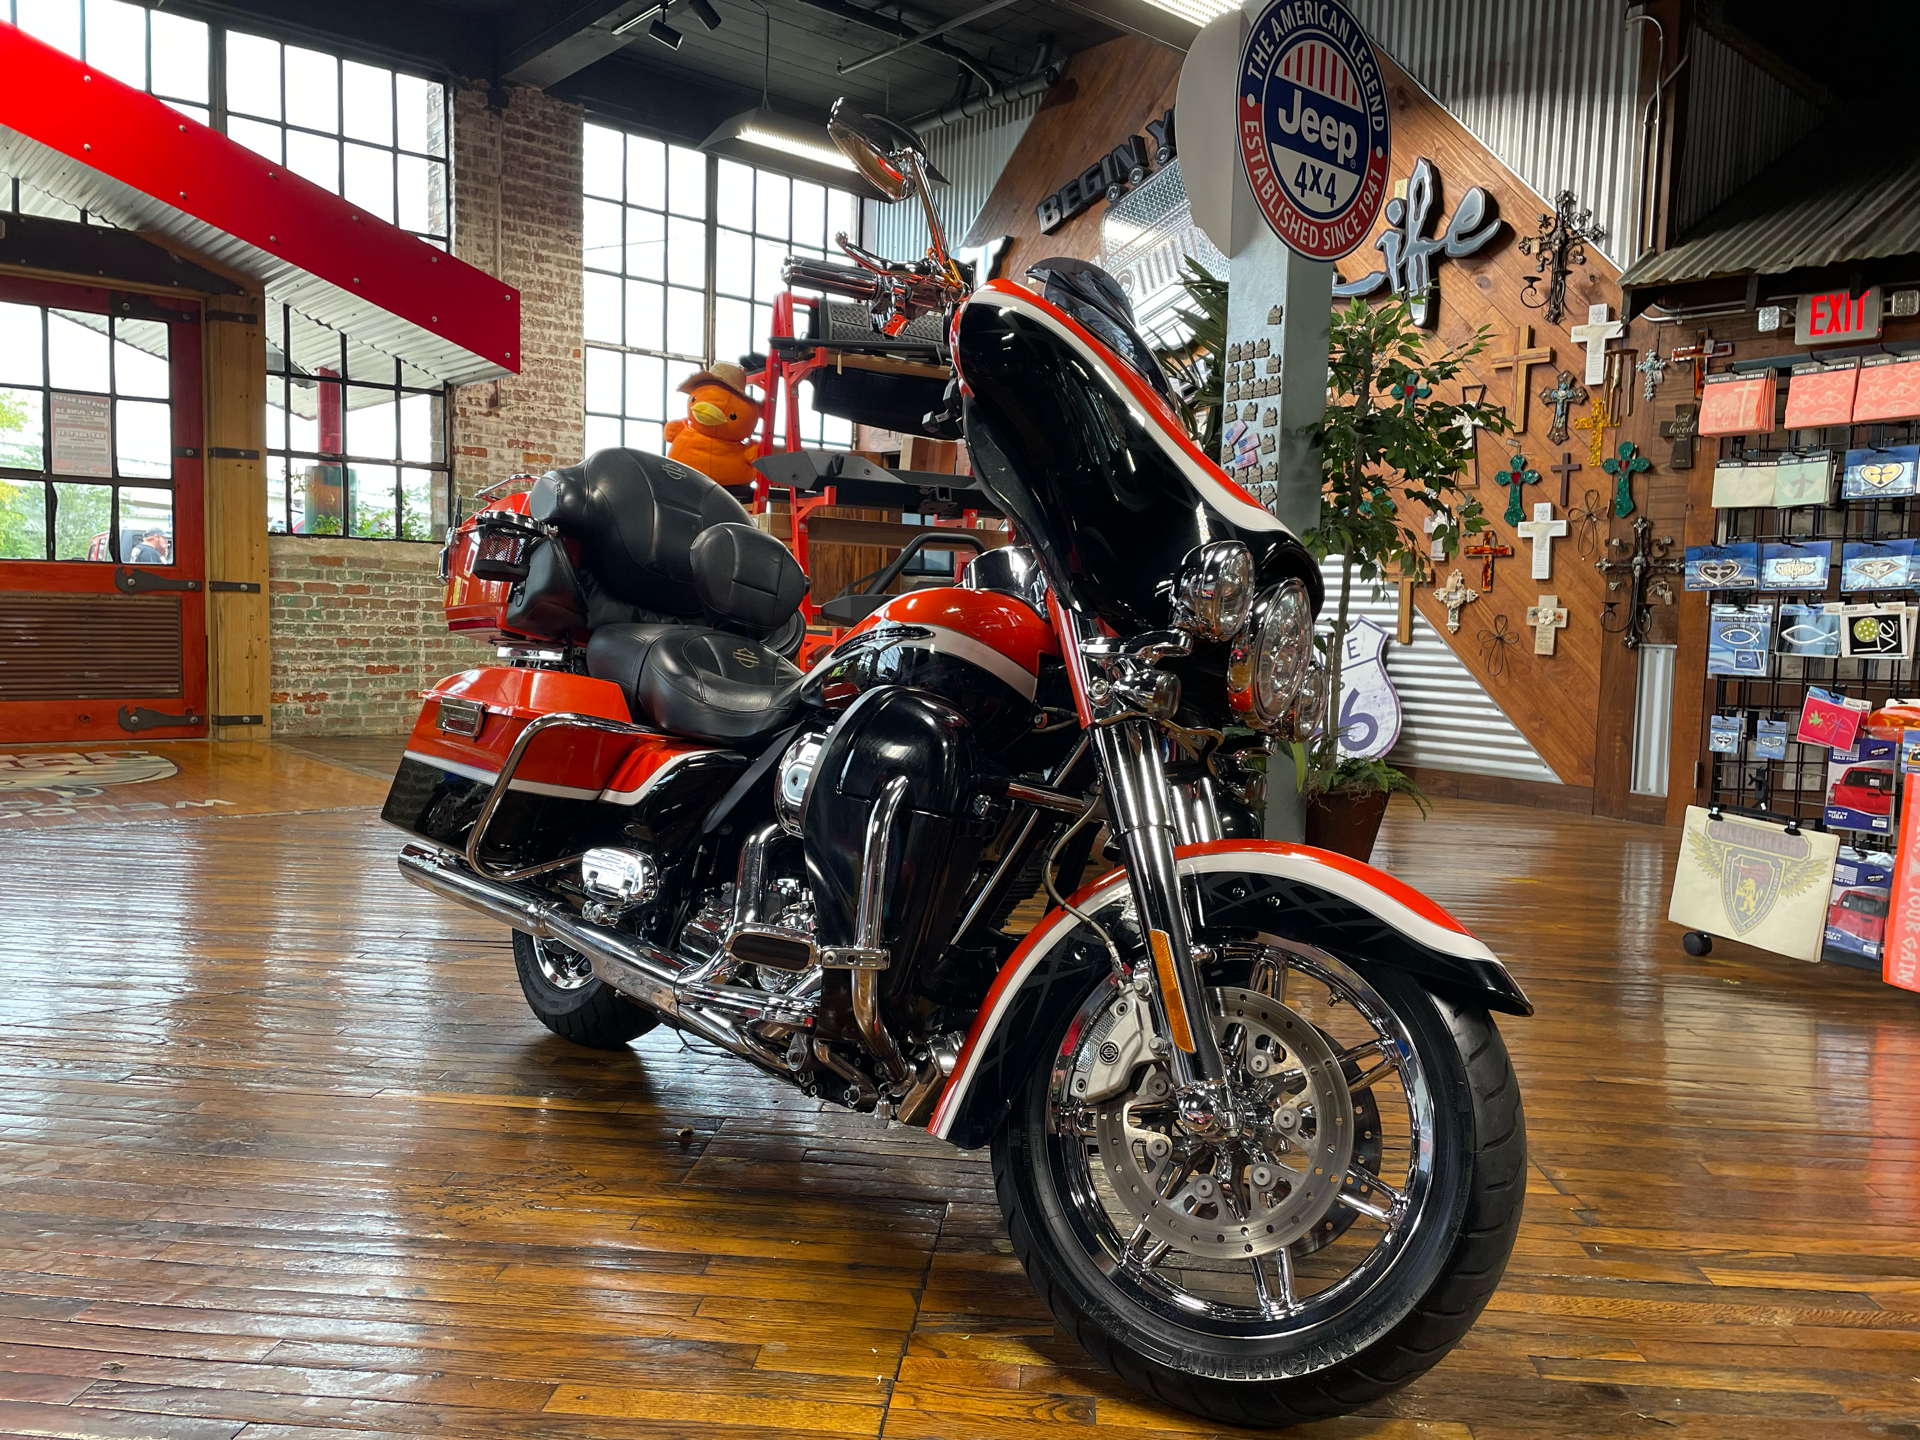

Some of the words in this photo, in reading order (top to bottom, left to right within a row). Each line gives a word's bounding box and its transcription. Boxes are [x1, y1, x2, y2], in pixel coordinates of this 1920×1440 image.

[1247, 30, 1275, 81] THE
[1270, 0, 1350, 44] AMERICAN
[1349, 34, 1385, 132] LEGEND
[1278, 88, 1358, 165] Jeep
[1036, 134, 1149, 235] BEGIN
[1244, 120, 1319, 248] ESTABLISHED
[1323, 210, 1362, 250] SINCE
[1358, 168, 1382, 219] 1941
[1294, 161, 1337, 208] 4X4
[1332, 156, 1501, 327] ife
[1809, 290, 1869, 336] EXIT
[1712, 821, 1807, 858] HELLFIGHTERS
[1123, 1304, 1143, 1321] FRONT
[1145, 1319, 1166, 1337] WHEEL
[1172, 1334, 1354, 1379] AMERICAN
